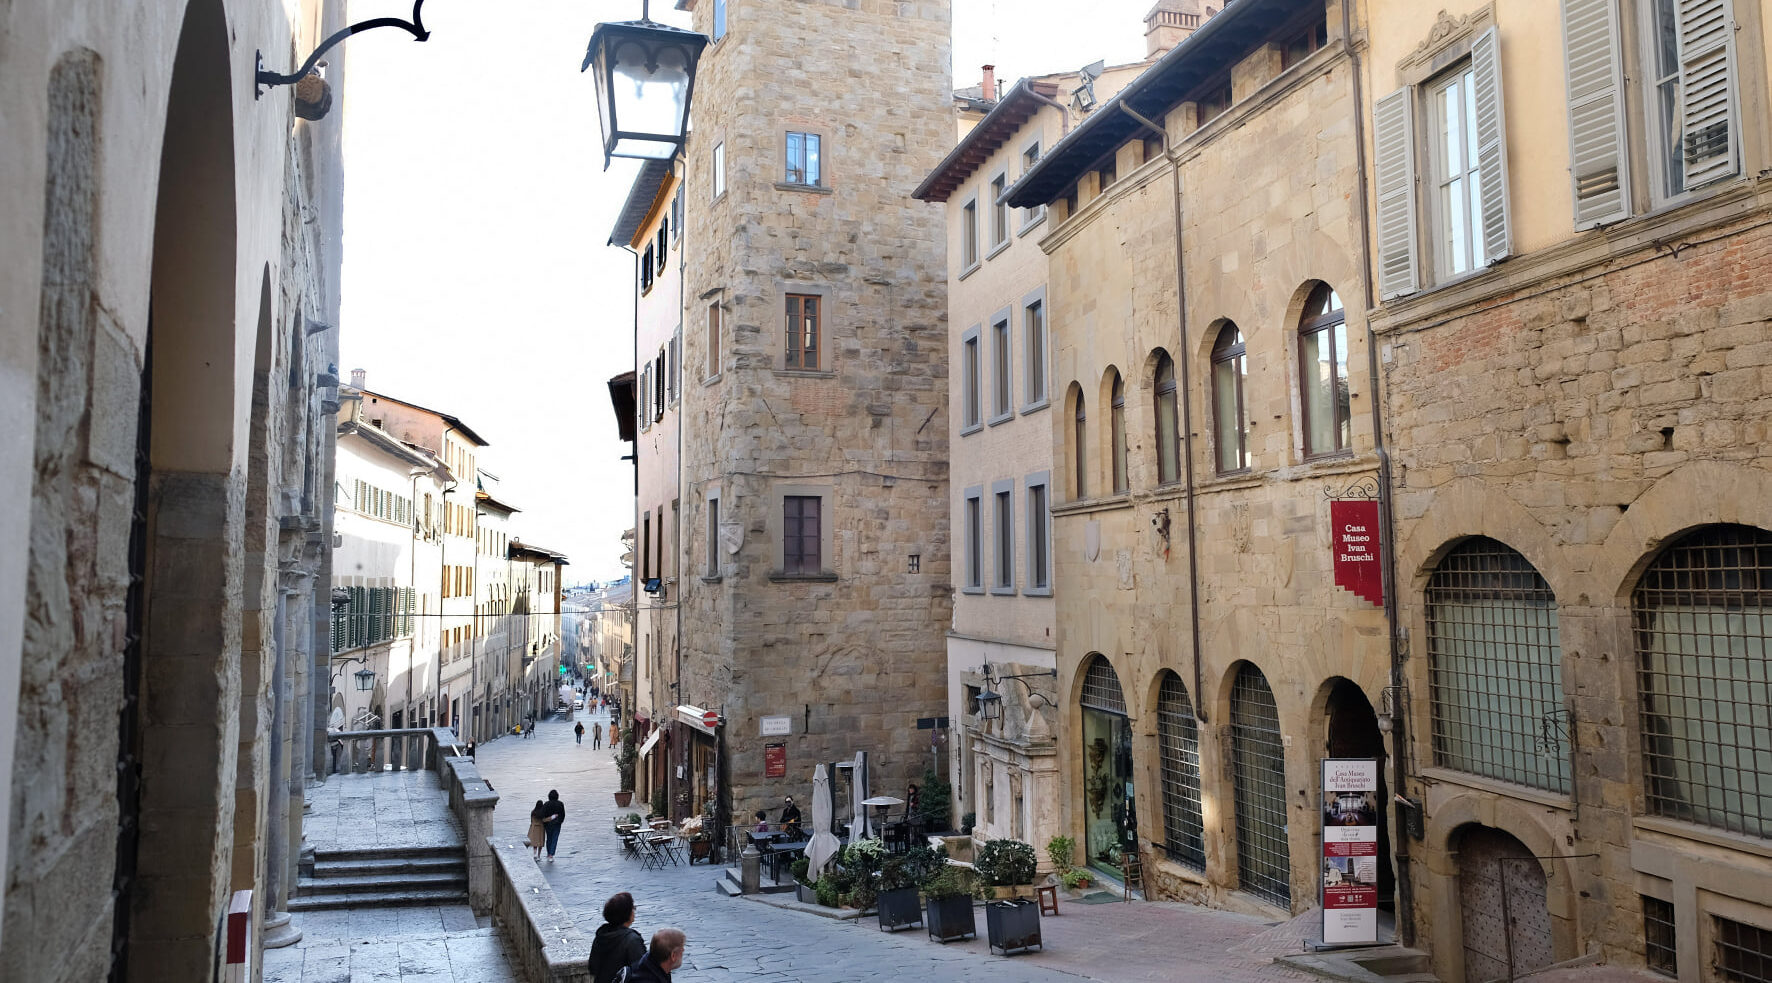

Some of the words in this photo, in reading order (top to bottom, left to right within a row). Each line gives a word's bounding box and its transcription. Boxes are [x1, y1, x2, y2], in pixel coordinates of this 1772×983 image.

[1345, 524, 1366, 532] Casa
[1342, 534, 1370, 542] Museo
[1347, 544, 1366, 552] Ivan
[1340, 553, 1374, 562] Bruschi
